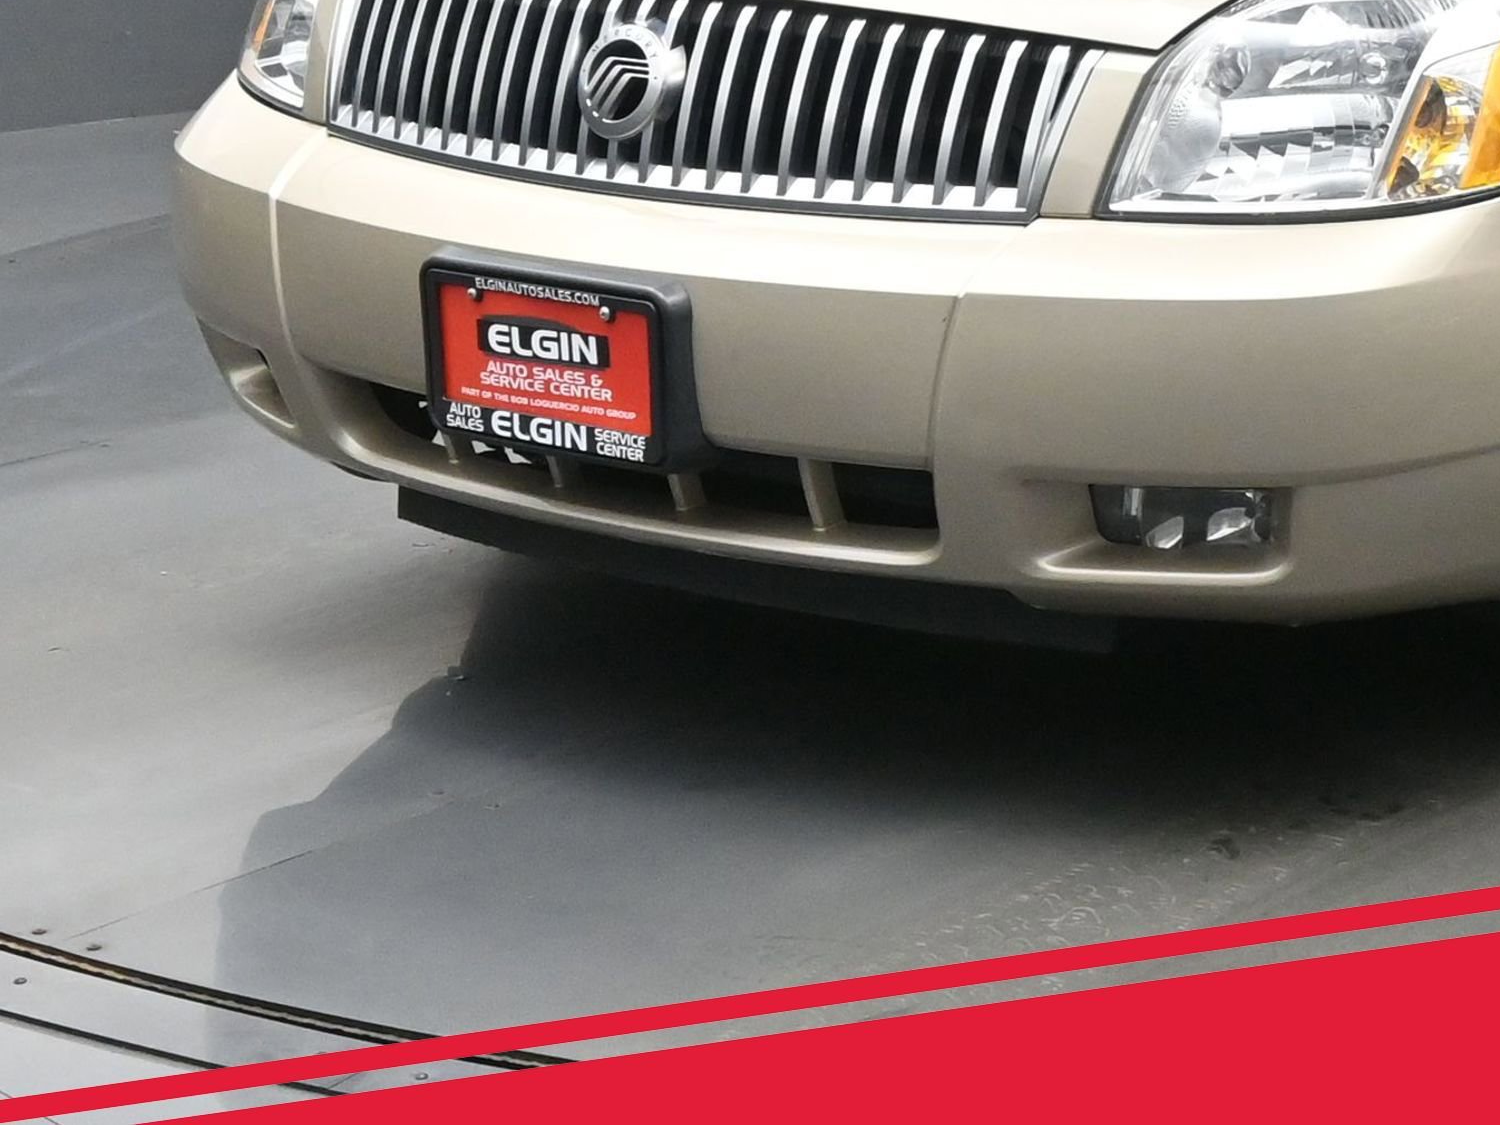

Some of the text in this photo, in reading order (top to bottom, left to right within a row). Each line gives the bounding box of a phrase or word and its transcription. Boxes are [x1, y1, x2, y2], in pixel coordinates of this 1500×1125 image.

[474, 276, 600, 306] ELGINAUTOSALES.COM
[487, 322, 599, 365] ELGIN
[486, 359, 604, 387] AUTO SALES &
[479, 371, 613, 403] SERVICE CENTER
[449, 401, 482, 419] AUTO
[581, 405, 605, 416] AUTO
[606, 408, 637, 420] GROUP
[446, 414, 485, 432] SALES
[491, 410, 588, 452] ELGIN
[594, 428, 646, 450] SERVICE
[596, 442, 644, 463] CENTER
